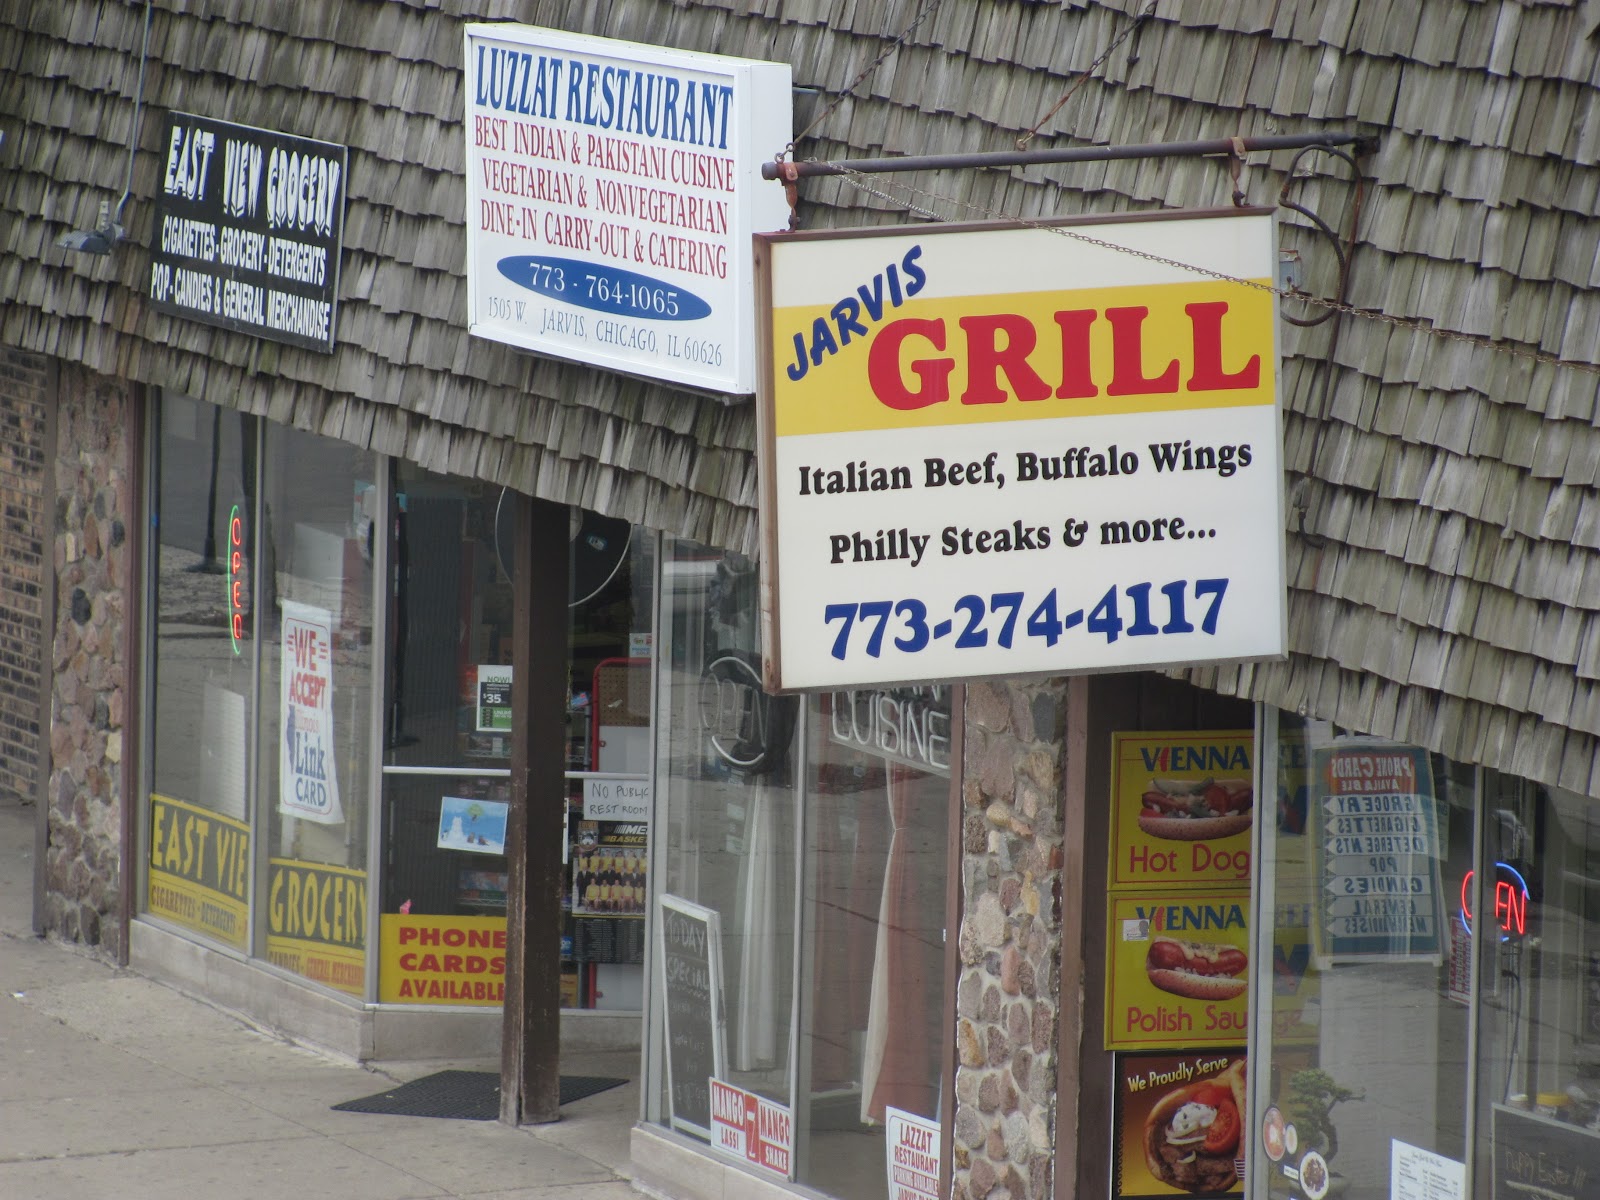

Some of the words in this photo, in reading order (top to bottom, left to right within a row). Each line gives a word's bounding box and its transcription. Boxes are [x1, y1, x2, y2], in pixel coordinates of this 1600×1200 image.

[475, 45, 562, 118] LUZZAT
[565, 60, 734, 150] RESTAURANT
[475, 115, 509, 151] BEST
[514, 122, 567, 162] INDIAN
[571, 132, 581, 165] &
[587, 134, 667, 182] PAKISTANI
[671, 149, 735, 193] CUISINE
[164, 126, 215, 200] EAST
[223, 138, 263, 218] VIEW
[267, 147, 340, 237] GROCERY
[482, 158, 573, 206] VEGETARIAN
[578, 175, 588, 209] &
[596, 178, 728, 236] NONVEGETARIAN
[481, 199, 537, 241] DINE-IN
[544, 211, 630, 258] CARRY-OUT
[634, 230, 644, 263] &
[649, 235, 727, 280] CATERING
[214, 277, 221, 315] &
[223, 279, 264, 326] GENERAL
[267, 289, 330, 341] MERCHANDISE
[529, 262, 565, 292] 773
[586, 274, 680, 317] 764-1065
[488, 296, 513, 321] 1505
[514, 300, 528, 325] W.
[540, 308, 588, 341] JARVIS,
[596, 320, 659, 356] CHICAGO,
[668, 335, 681, 358] IL
[684, 338, 722, 367] 60626
[786, 244, 928, 382] JARVIS
[868, 301, 1261, 411] GRILL
[799, 460, 913, 496] Italian
[924, 452, 1005, 489] Beef,
[1016, 444, 1139, 482] Buffalo
[1149, 440, 1252, 478] Wings
[829, 520, 930, 568] Philly
[940, 518, 1052, 557] Steaks
[1063, 519, 1089, 547] &
[1100, 513, 1218, 546] more...
[824, 577, 1230, 661] 773-274-4117
[294, 627, 317, 671] WE
[289, 672, 326, 711] ACCEPT
[483, 693, 502, 704] $35
[832, 690, 949, 769] CUISINE
[295, 730, 326, 780] Link
[1140, 745, 1252, 772] VIENNA
[295, 778, 327, 808] CARD
[592, 783, 609, 798] NO
[617, 785, 649, 798] PUBLIC
[624, 825, 648, 835] ME
[152, 805, 209, 880] EAST
[216, 825, 248, 897] VIE
[1129, 846, 1177, 873] Hot
[1192, 843, 1250, 879] Dog
[269, 868, 367, 946] GROCERY
[1136, 904, 1246, 931] VIENNA
[399, 927, 507, 949] PHONE
[399, 953, 506, 975] CARDS
[399, 978, 504, 1001] AVAILABLE
[1127, 1006, 1193, 1033] Polish
[1127, 1075, 1147, 1093] We
[1149, 1062, 1194, 1088] Proudly
[1196, 1058, 1228, 1075] Serve
[713, 1085, 744, 1126] MANGO
[760, 1105, 790, 1146] MANGO
[721, 1126, 739, 1150] LASSI
[766, 1146, 787, 1170] SHAKE
[900, 1123, 932, 1154] LAZZAT
[895, 1145, 938, 1175] RESTAURANT
